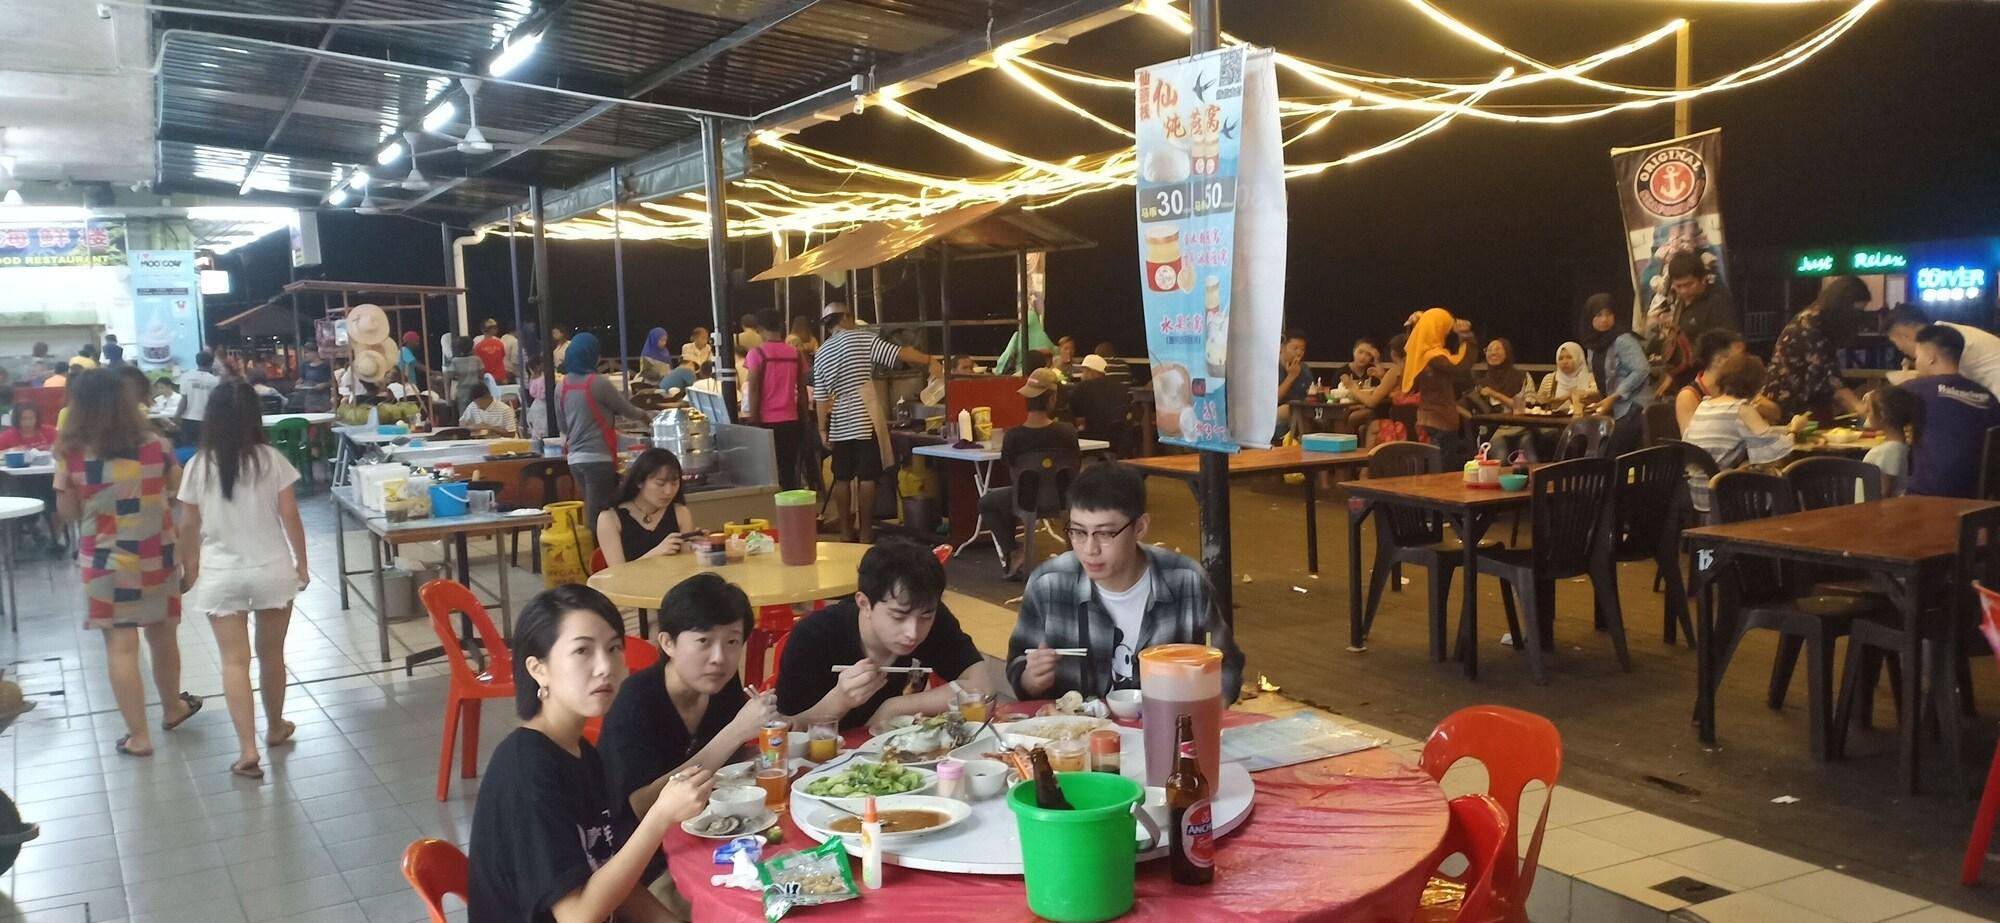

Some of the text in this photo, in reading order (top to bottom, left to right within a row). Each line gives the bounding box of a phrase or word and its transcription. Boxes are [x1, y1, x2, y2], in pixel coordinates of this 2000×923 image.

[1640, 150, 1702, 182] ORIGINAL
[1157, 189, 1183, 217] 30
[1205, 182, 1223, 210] 50
[25, 255, 109, 264] RESTAURANT
[1797, 251, 1907, 271] Just Relax
